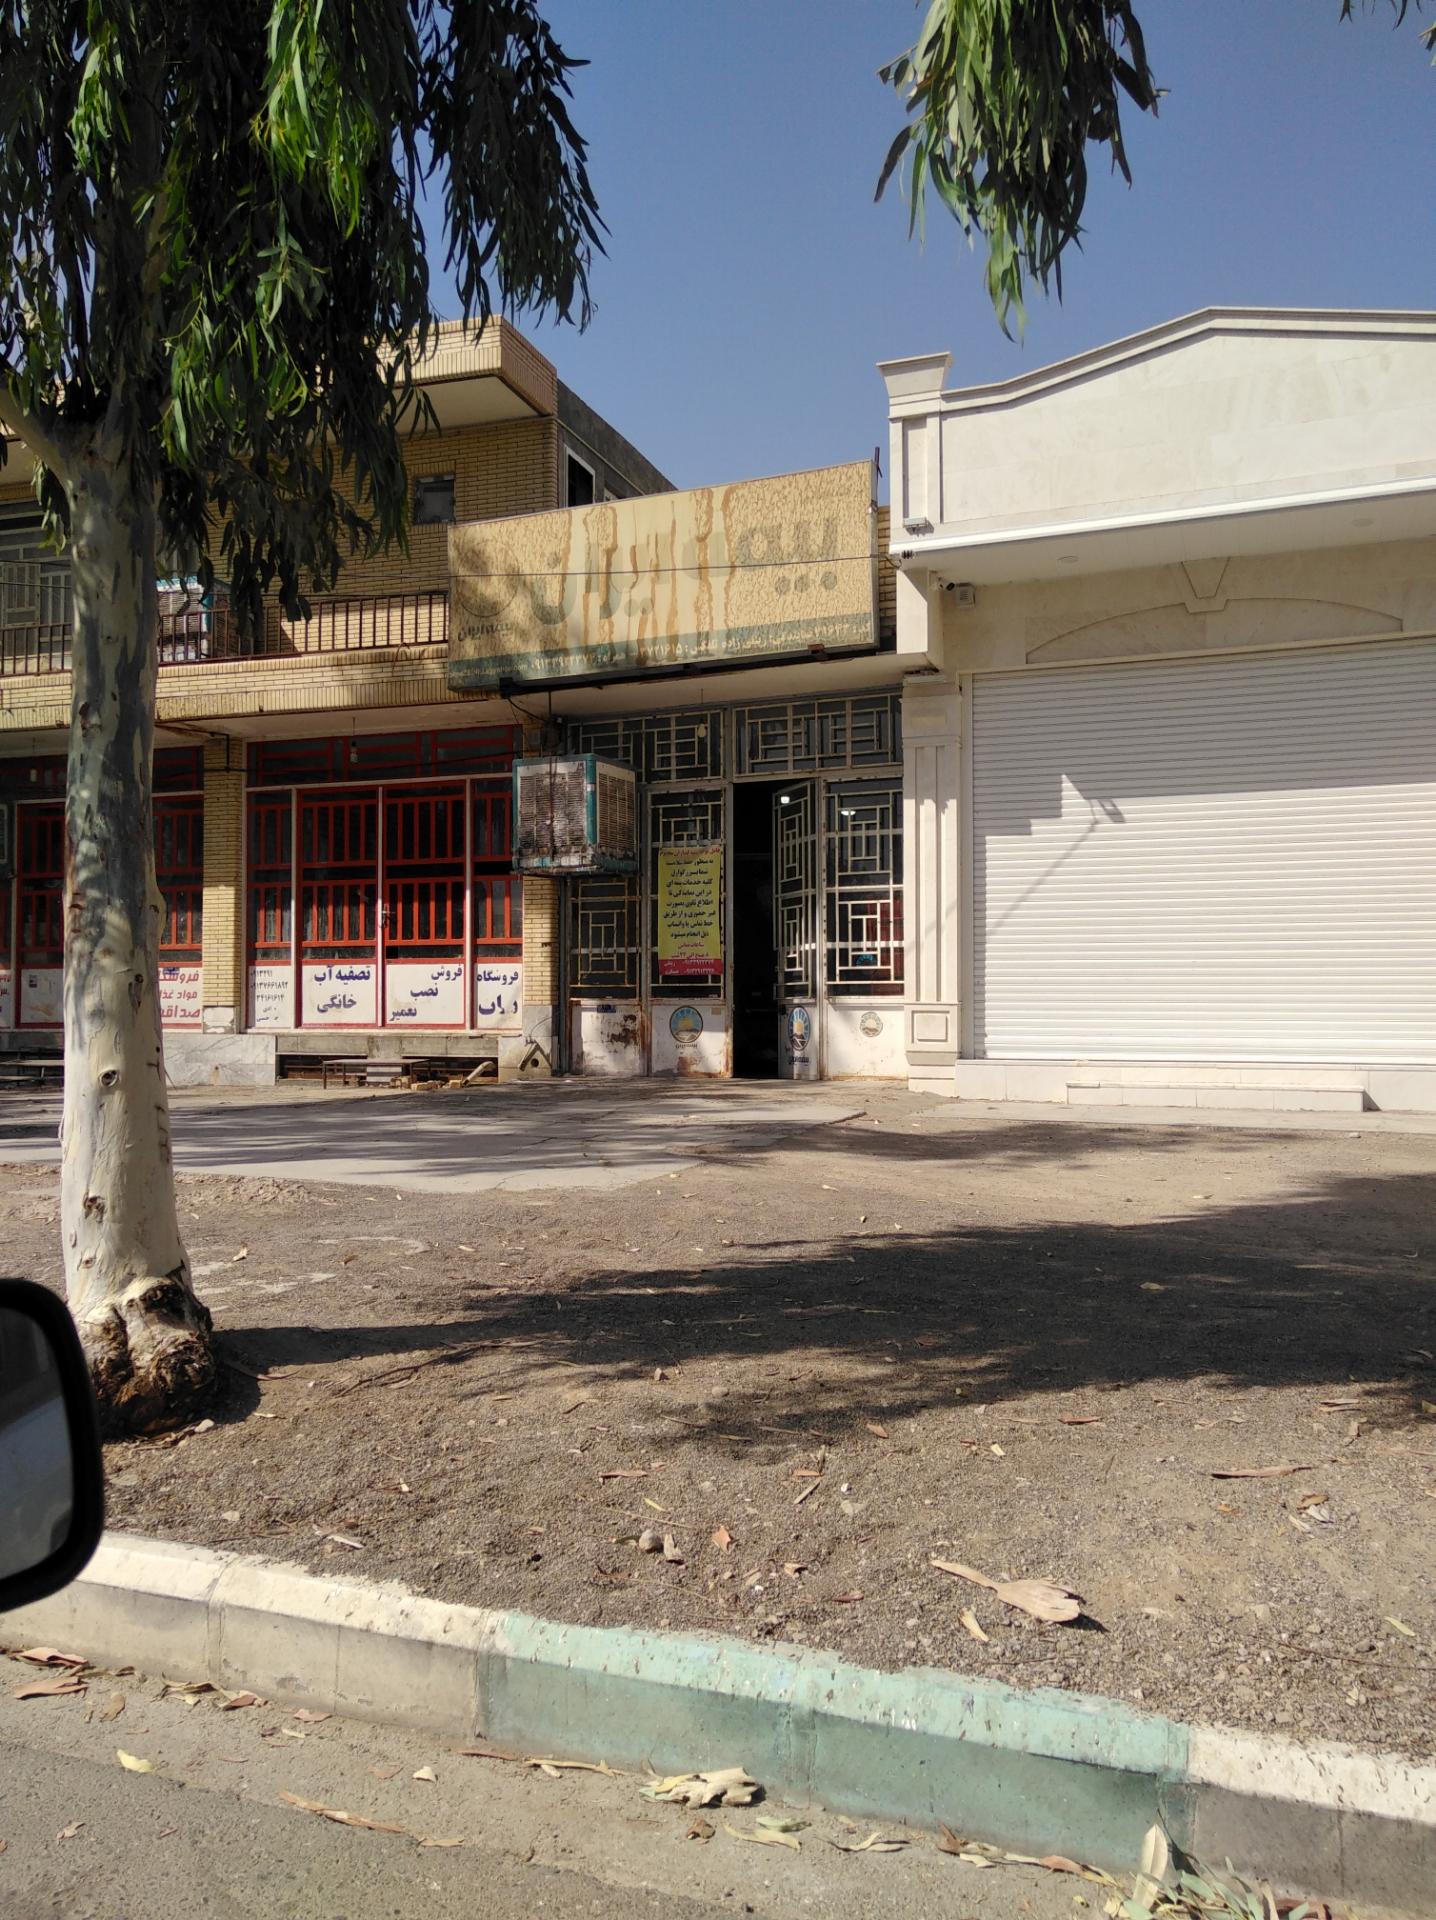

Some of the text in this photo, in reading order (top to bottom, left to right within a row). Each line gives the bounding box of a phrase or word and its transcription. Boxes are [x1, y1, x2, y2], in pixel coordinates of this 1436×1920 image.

[313, 965, 371, 984] تصفیه آب
[431, 963, 463, 981] فروش
[476, 968, 519, 985] فروشگاه
[176, 989, 198, 1001] مواد
[410, 982, 439, 1001] نصب
[317, 994, 357, 1013] خانگی
[389, 1005, 418, 1022] تعمیر
